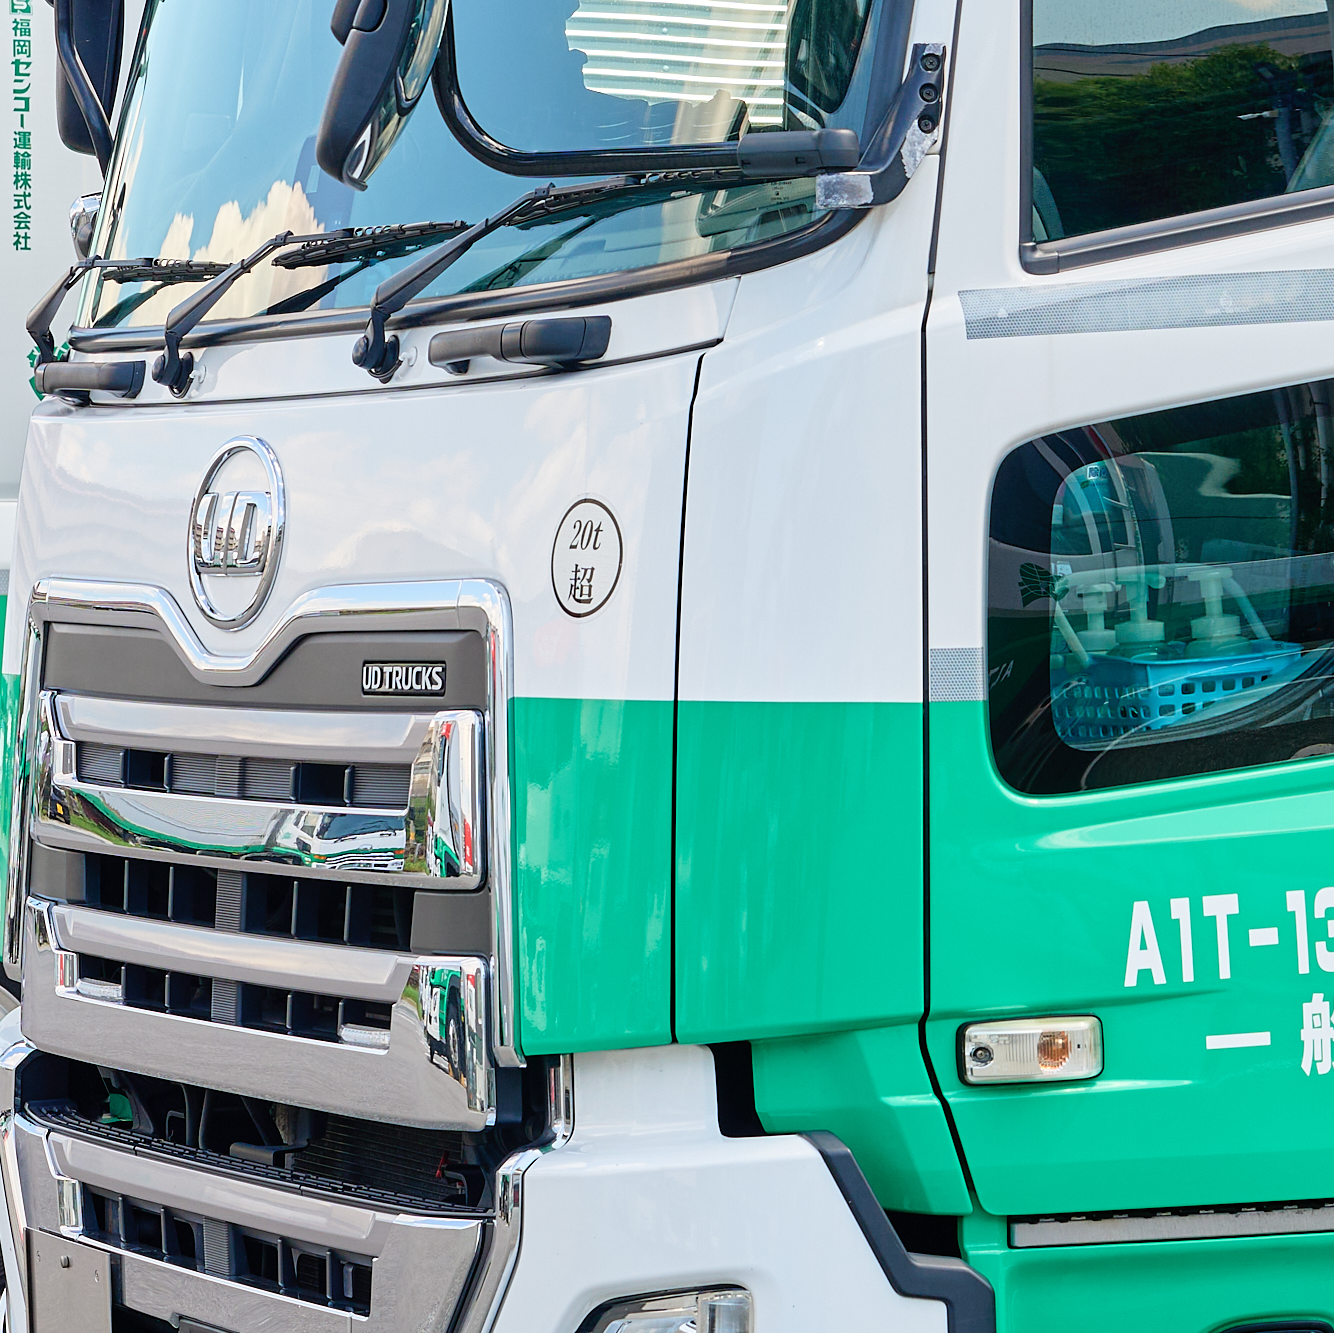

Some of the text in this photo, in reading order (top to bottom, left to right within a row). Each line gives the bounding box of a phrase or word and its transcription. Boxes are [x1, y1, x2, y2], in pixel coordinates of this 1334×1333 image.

[11, 18, 32, 251] 福岡センコー運輸株式会社
[195, 491, 272, 577] UD
[569, 519, 604, 551] 20t
[567, 563, 596, 605] 超
[362, 666, 443, 691] UD TRUCKS
